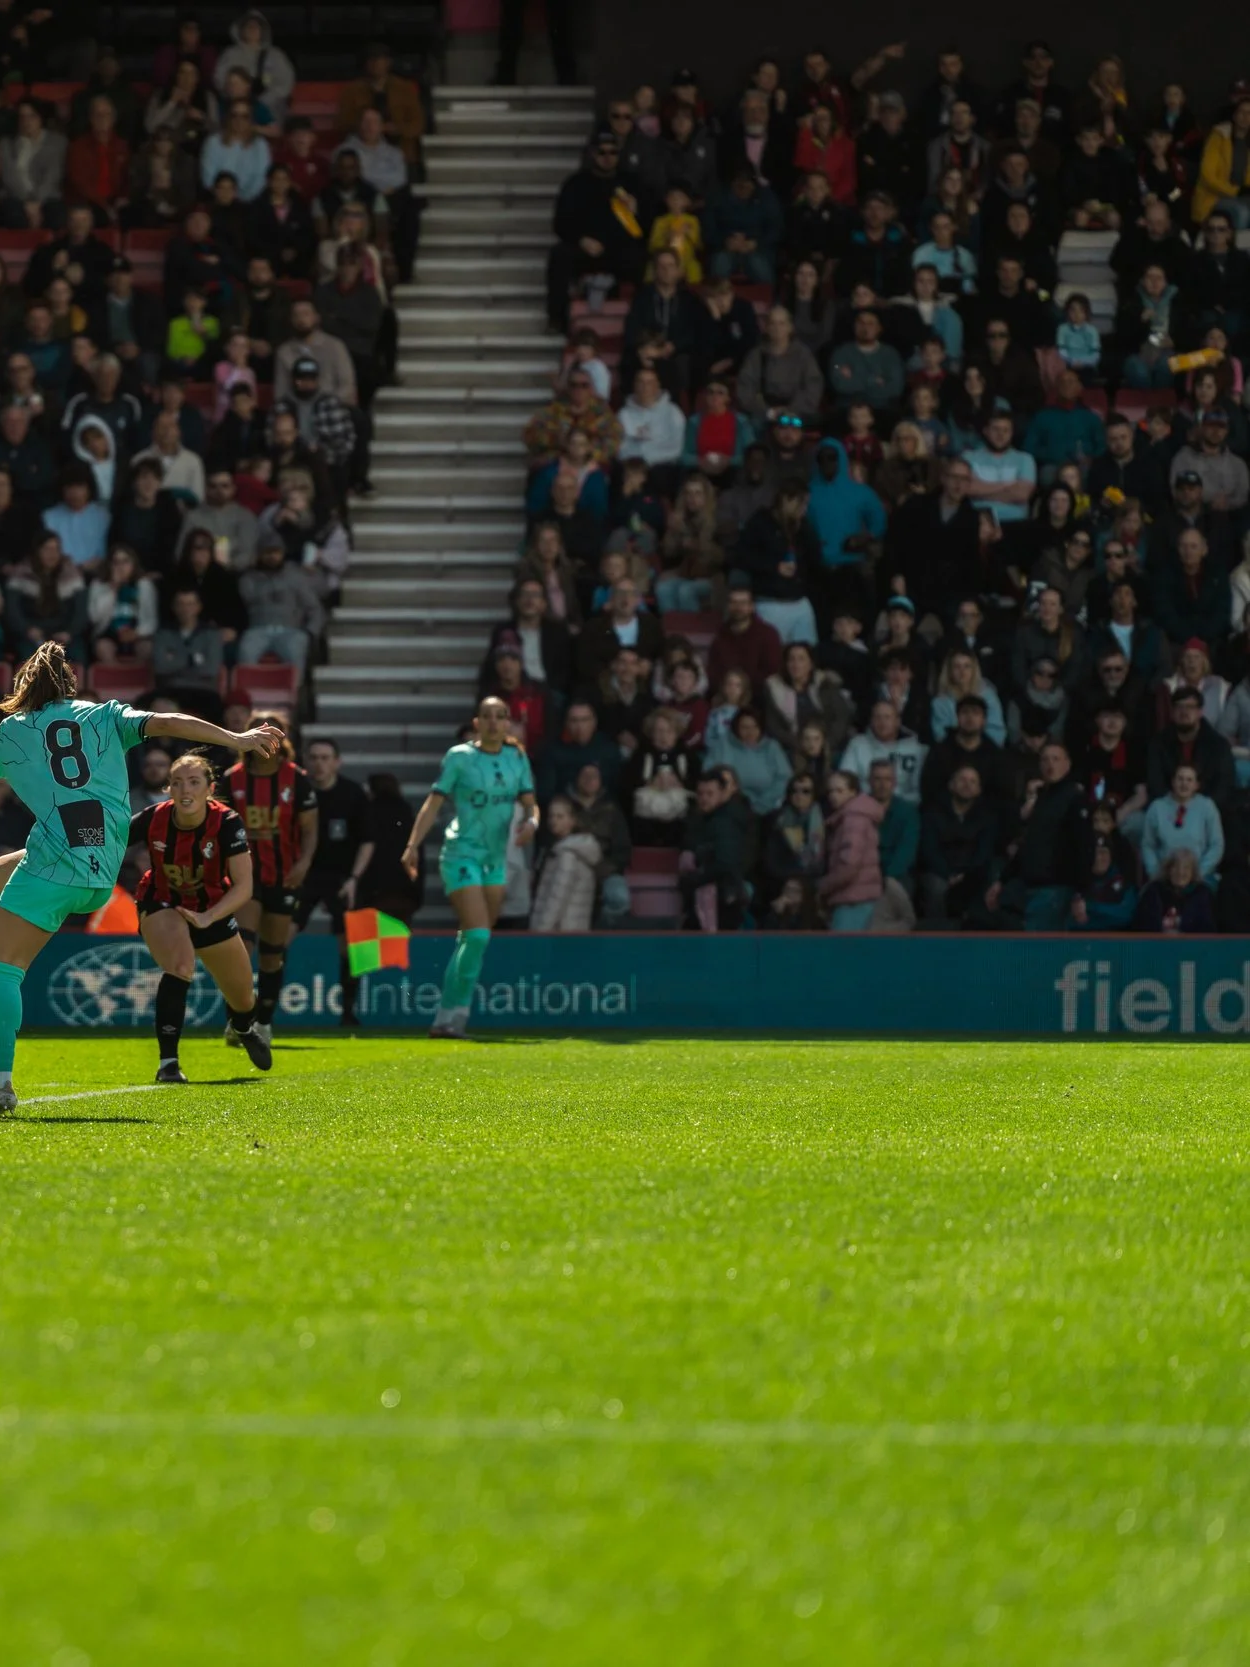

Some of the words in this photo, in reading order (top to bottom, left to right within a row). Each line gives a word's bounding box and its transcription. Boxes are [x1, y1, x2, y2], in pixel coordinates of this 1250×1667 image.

[45, 719, 91, 789] 8
[77, 827, 105, 838] STONE
[83, 836, 105, 846] RIDGE
